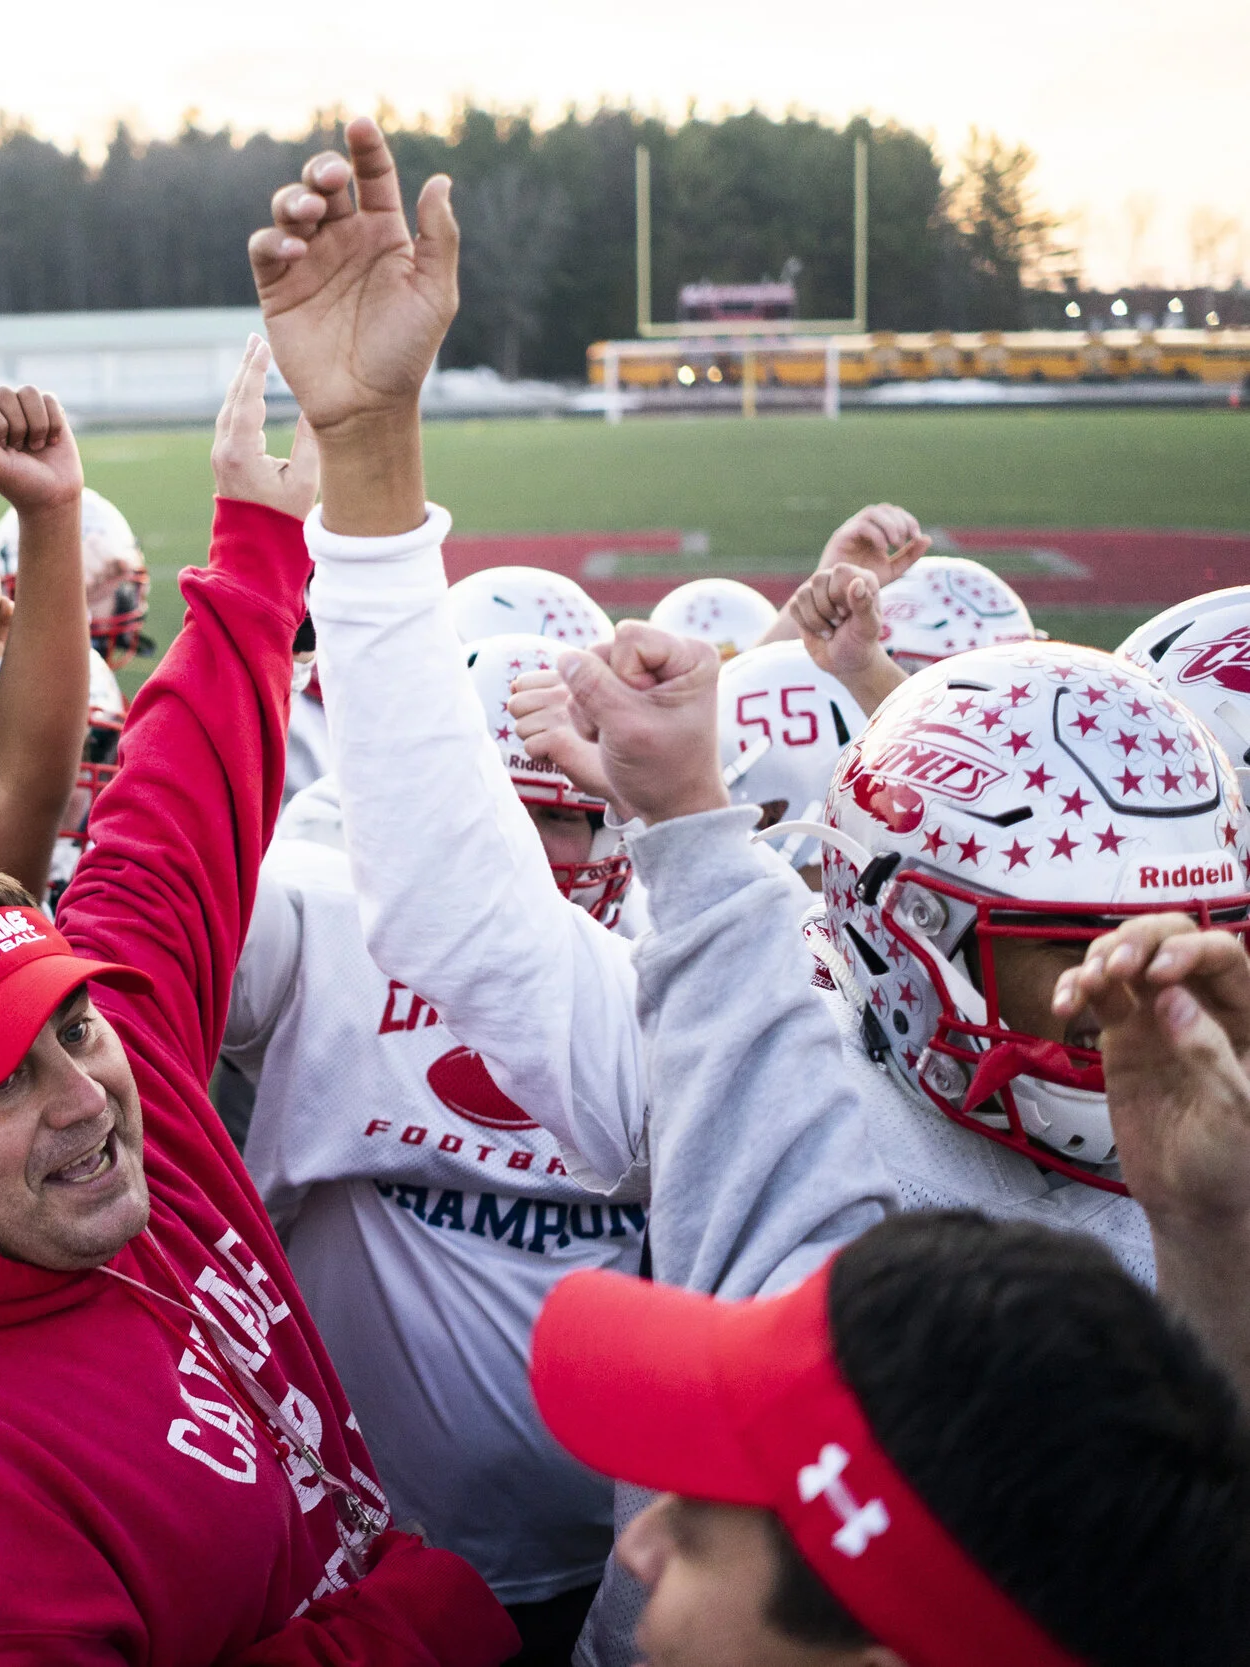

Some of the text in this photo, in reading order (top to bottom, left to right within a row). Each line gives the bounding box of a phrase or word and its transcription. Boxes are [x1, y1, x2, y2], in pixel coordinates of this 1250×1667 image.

[737, 685, 817, 752] 55
[1139, 862, 1233, 888] Riddell
[364, 1119, 567, 1176] FOOTBA
